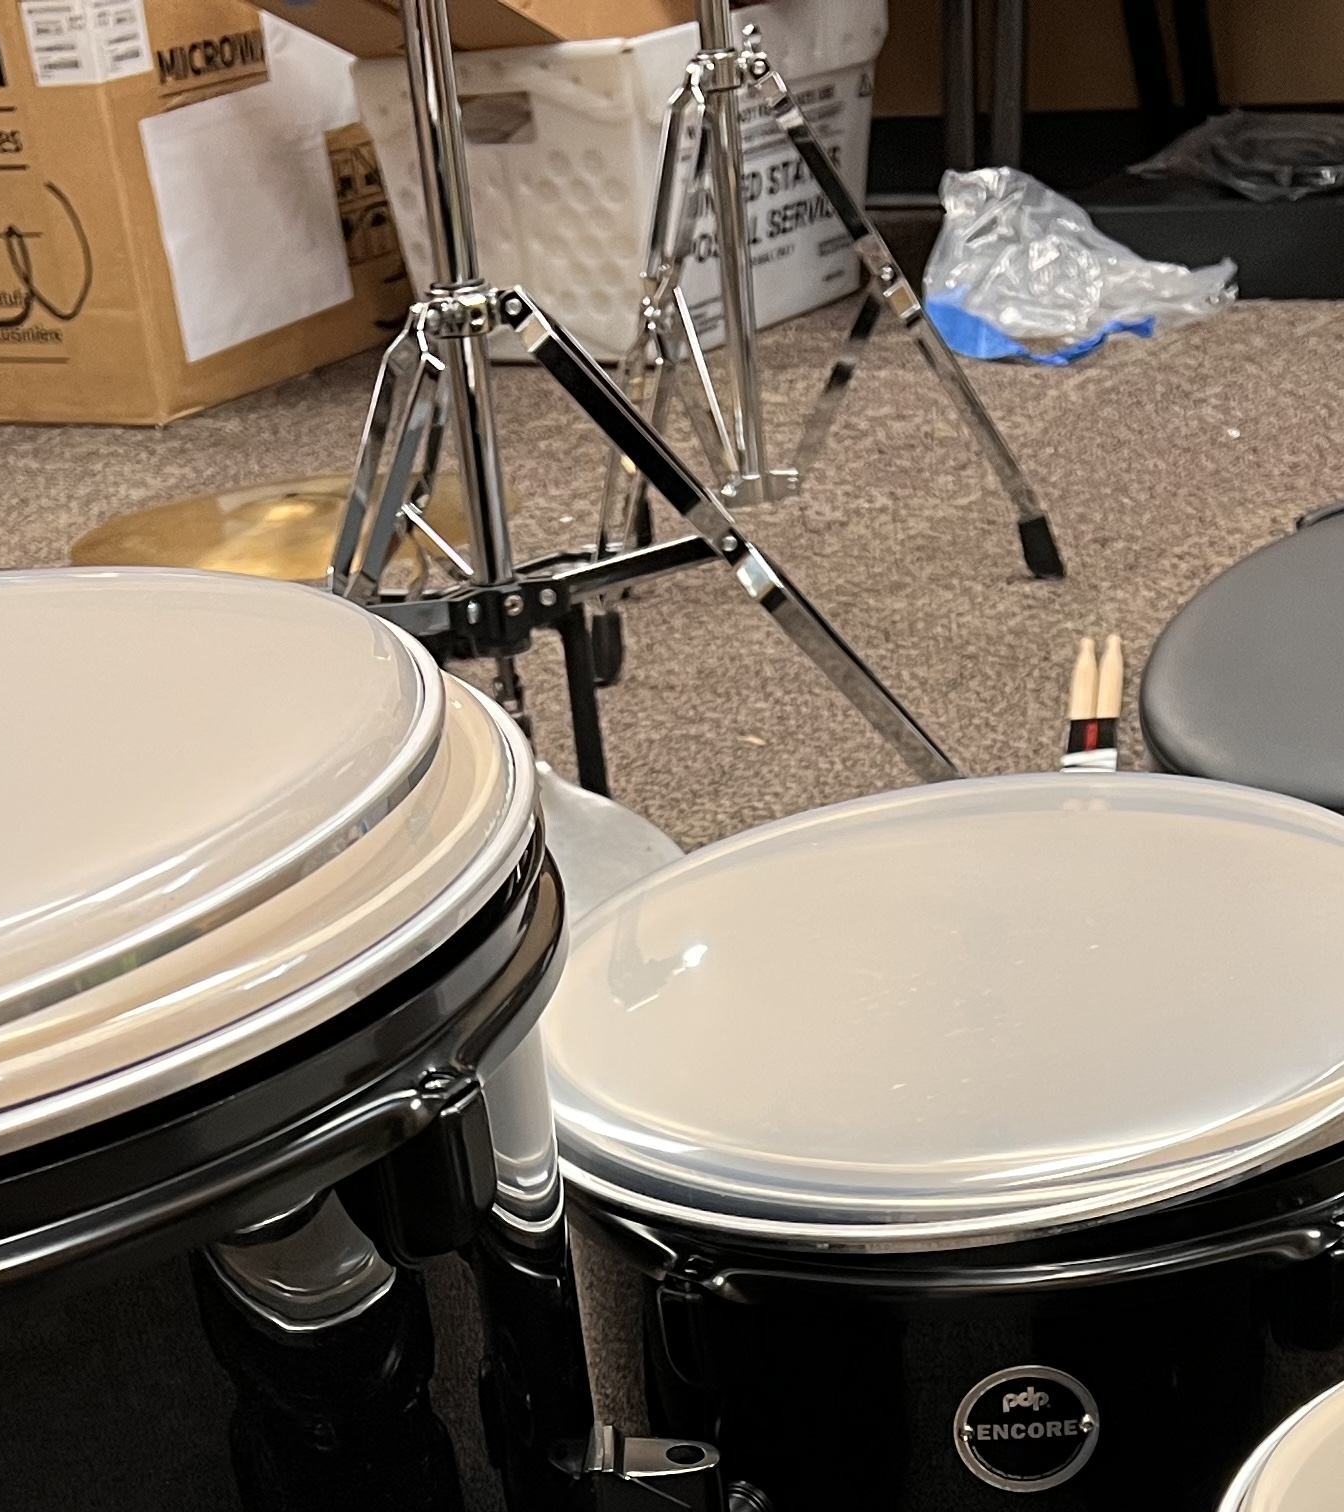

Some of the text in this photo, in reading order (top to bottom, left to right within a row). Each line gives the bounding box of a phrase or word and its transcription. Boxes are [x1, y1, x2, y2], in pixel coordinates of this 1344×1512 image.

[157, 30, 265, 84] MICROW
[767, 195, 833, 239] SERVI
[976, 1419, 1078, 1441] ENCORE
